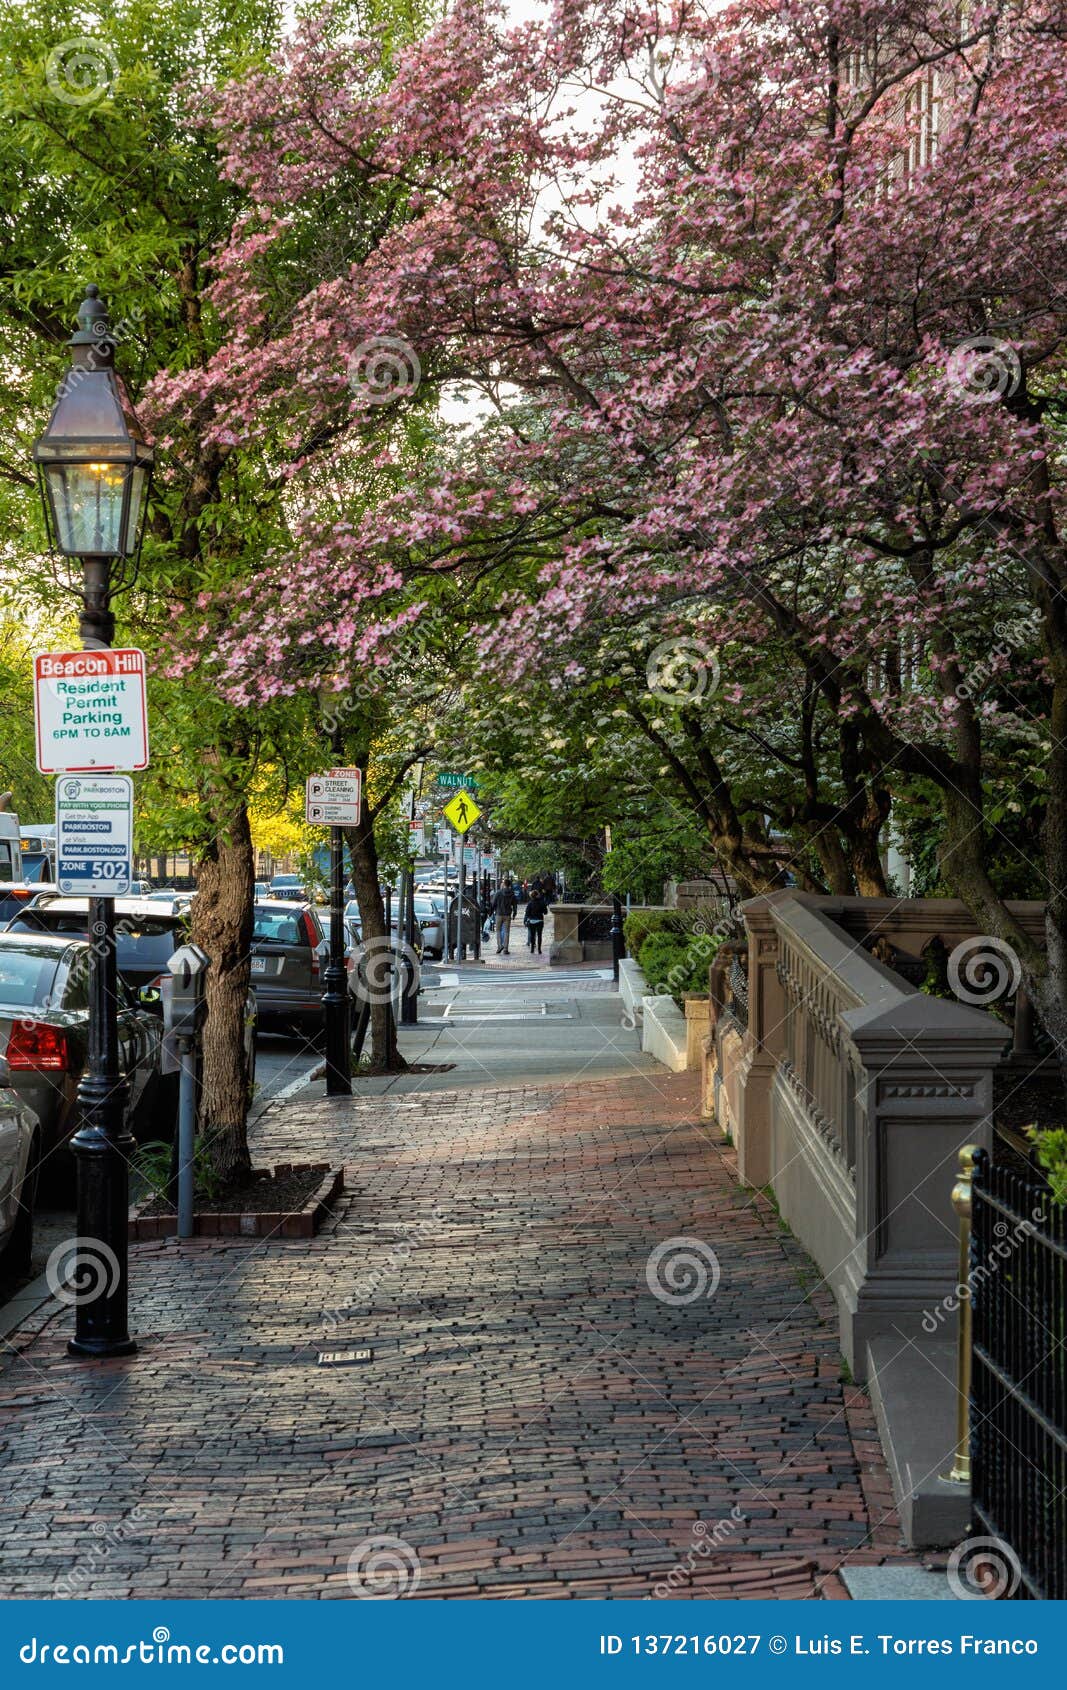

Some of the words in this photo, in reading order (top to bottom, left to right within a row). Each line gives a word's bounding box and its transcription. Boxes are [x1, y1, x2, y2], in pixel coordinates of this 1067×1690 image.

[40, 659, 107, 676] Beacon
[114, 654, 141, 671] Hill
[56, 680, 126, 694] Resident
[66, 696, 118, 708] Permit
[63, 712, 122, 725] Parking
[52, 729, 79, 739] 6PM
[83, 728, 100, 738] TO
[104, 727, 130, 737] 8AM
[440, 775, 473, 786] WALNUT
[64, 823, 109, 831] PARKBOSTON
[62, 862, 87, 871] ZONE
[92, 862, 126, 879] 502
